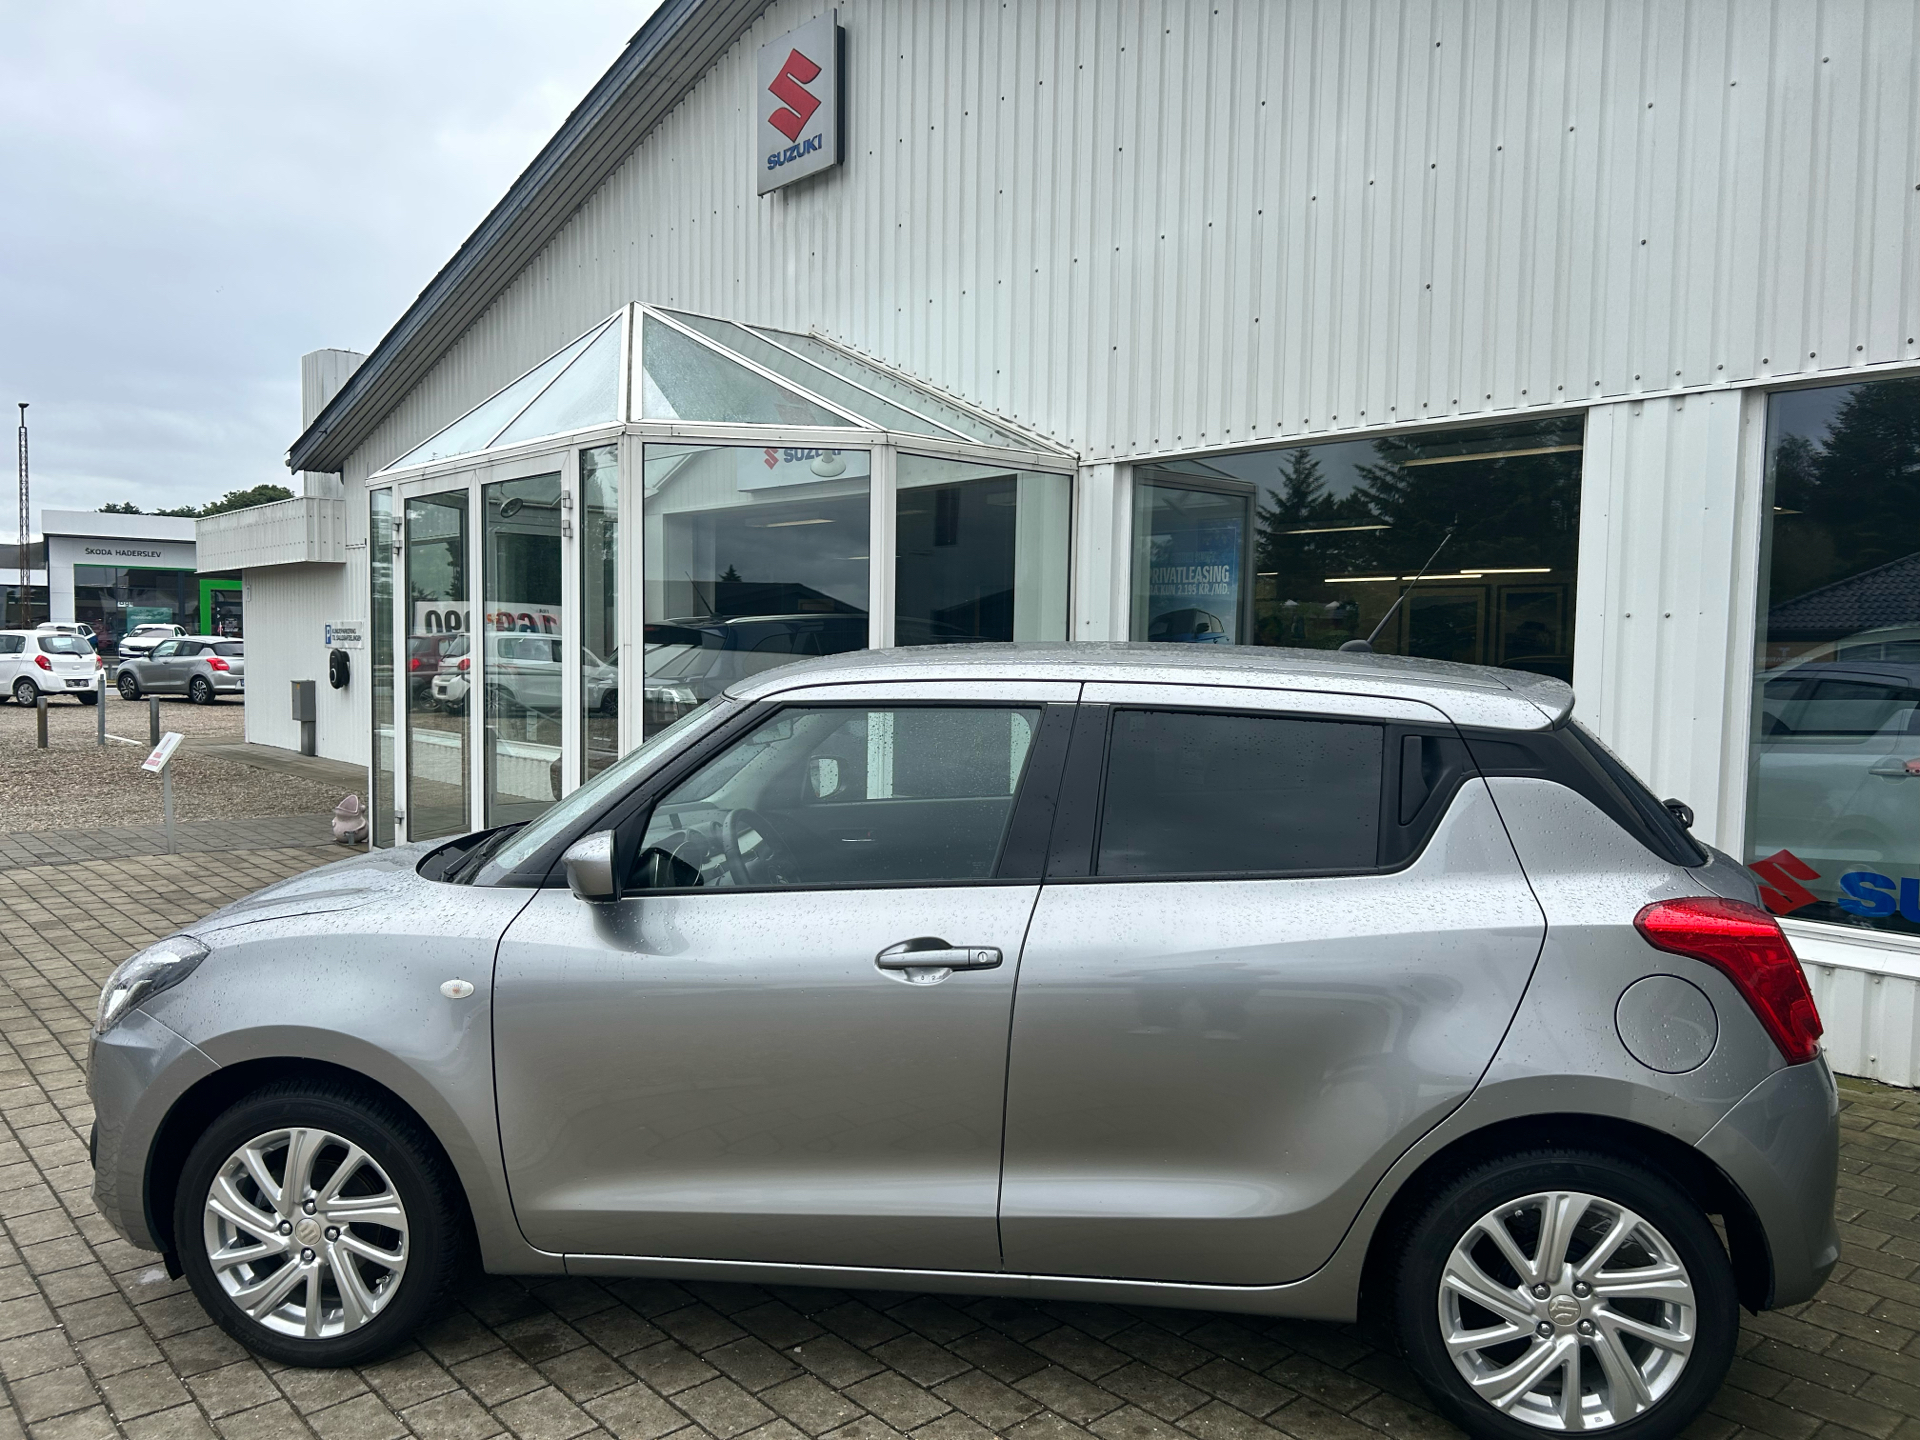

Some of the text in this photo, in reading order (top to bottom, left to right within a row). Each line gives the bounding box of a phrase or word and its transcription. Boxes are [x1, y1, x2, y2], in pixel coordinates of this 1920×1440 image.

[767, 133, 823, 171] SUZUKI
[783, 449, 842, 463] SUZ
[85, 547, 162, 558] ŠKODA HADERSLEV
